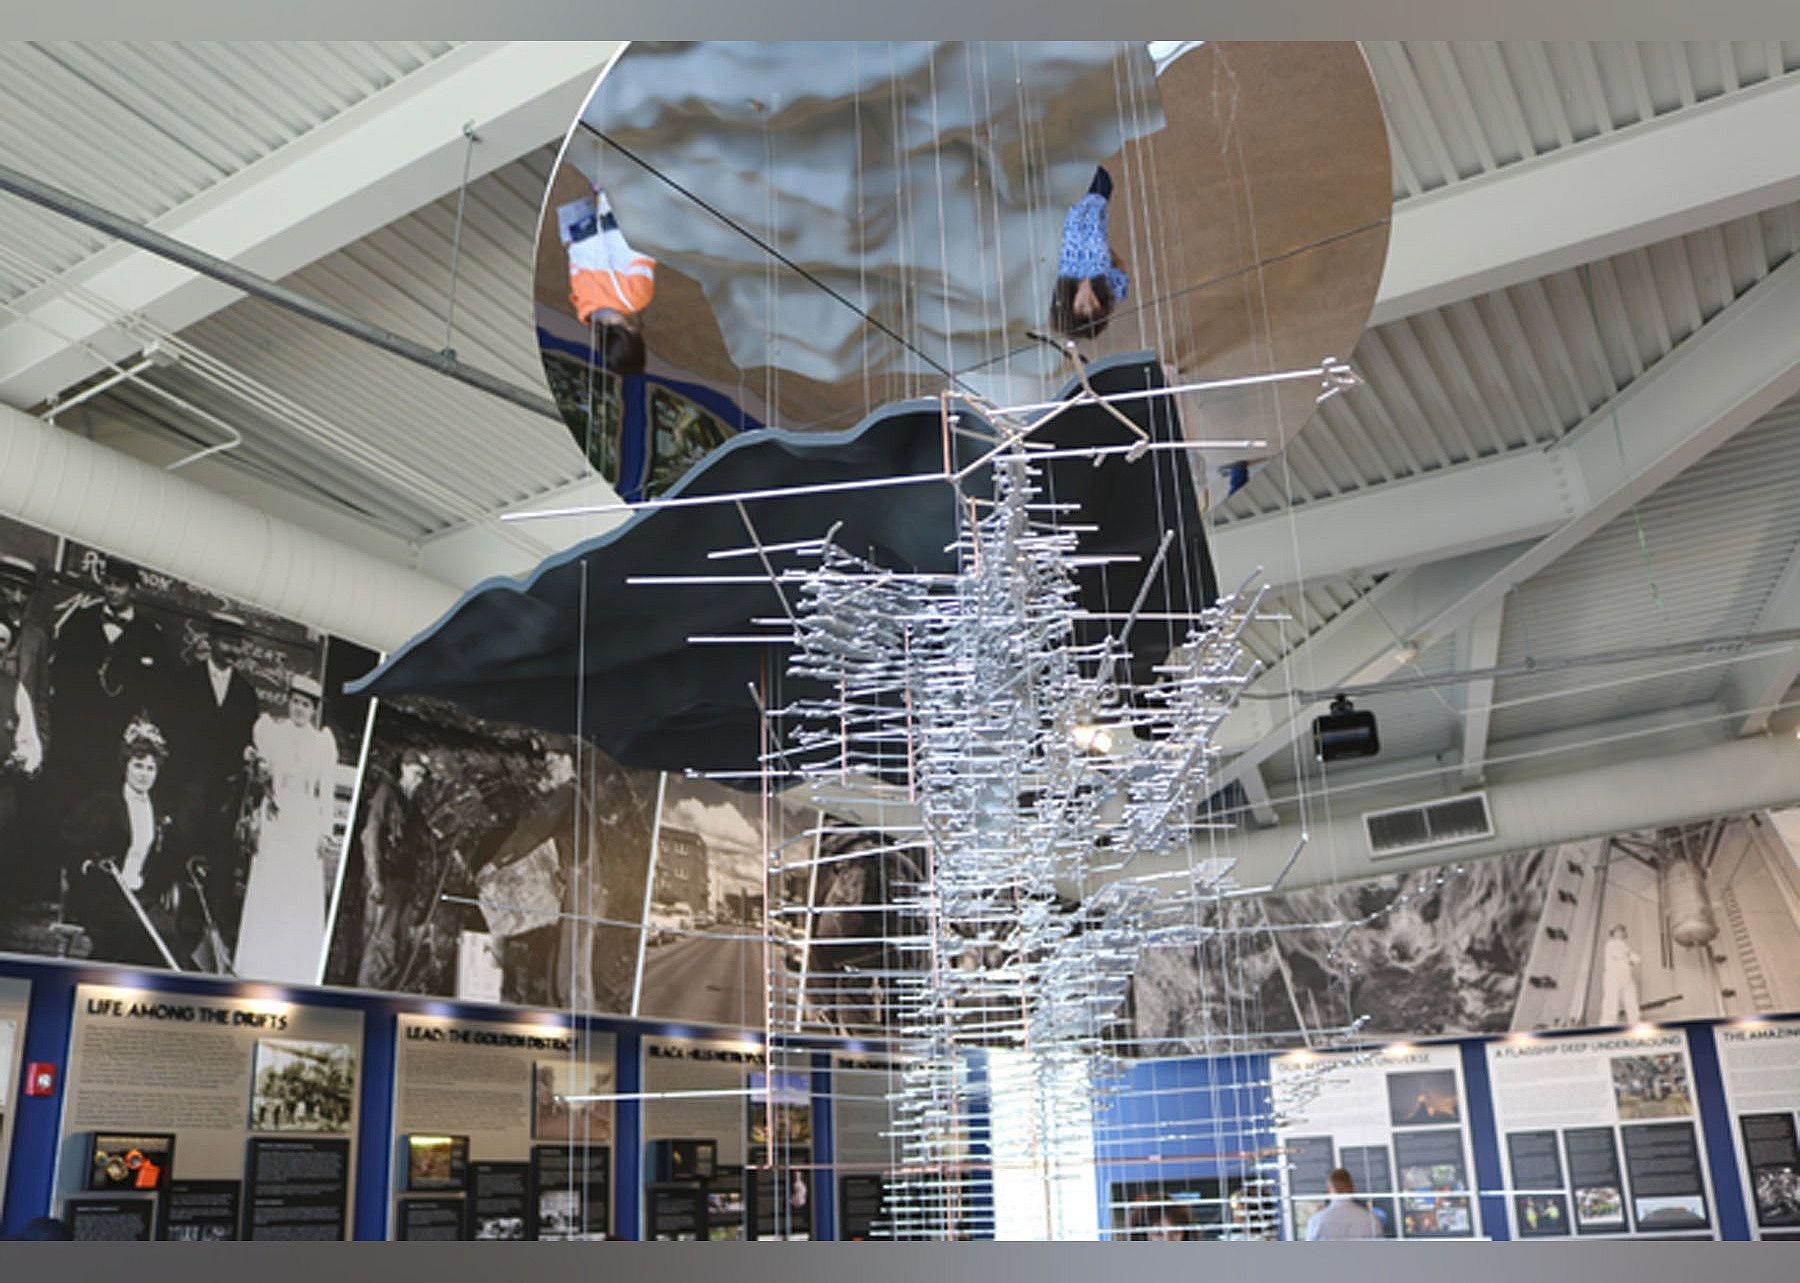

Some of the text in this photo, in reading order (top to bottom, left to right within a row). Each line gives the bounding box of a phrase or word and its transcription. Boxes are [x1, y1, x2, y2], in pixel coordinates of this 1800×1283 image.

[87, 999, 288, 1030] LIFE AMONG THE DRIFTS
[1506, 1044, 1557, 1057] FLAGSHIP
[1561, 1042, 1587, 1054] DEEP
[1591, 1035, 1682, 1051] UNDERGROUND
[1723, 1032, 1746, 1042] THE
